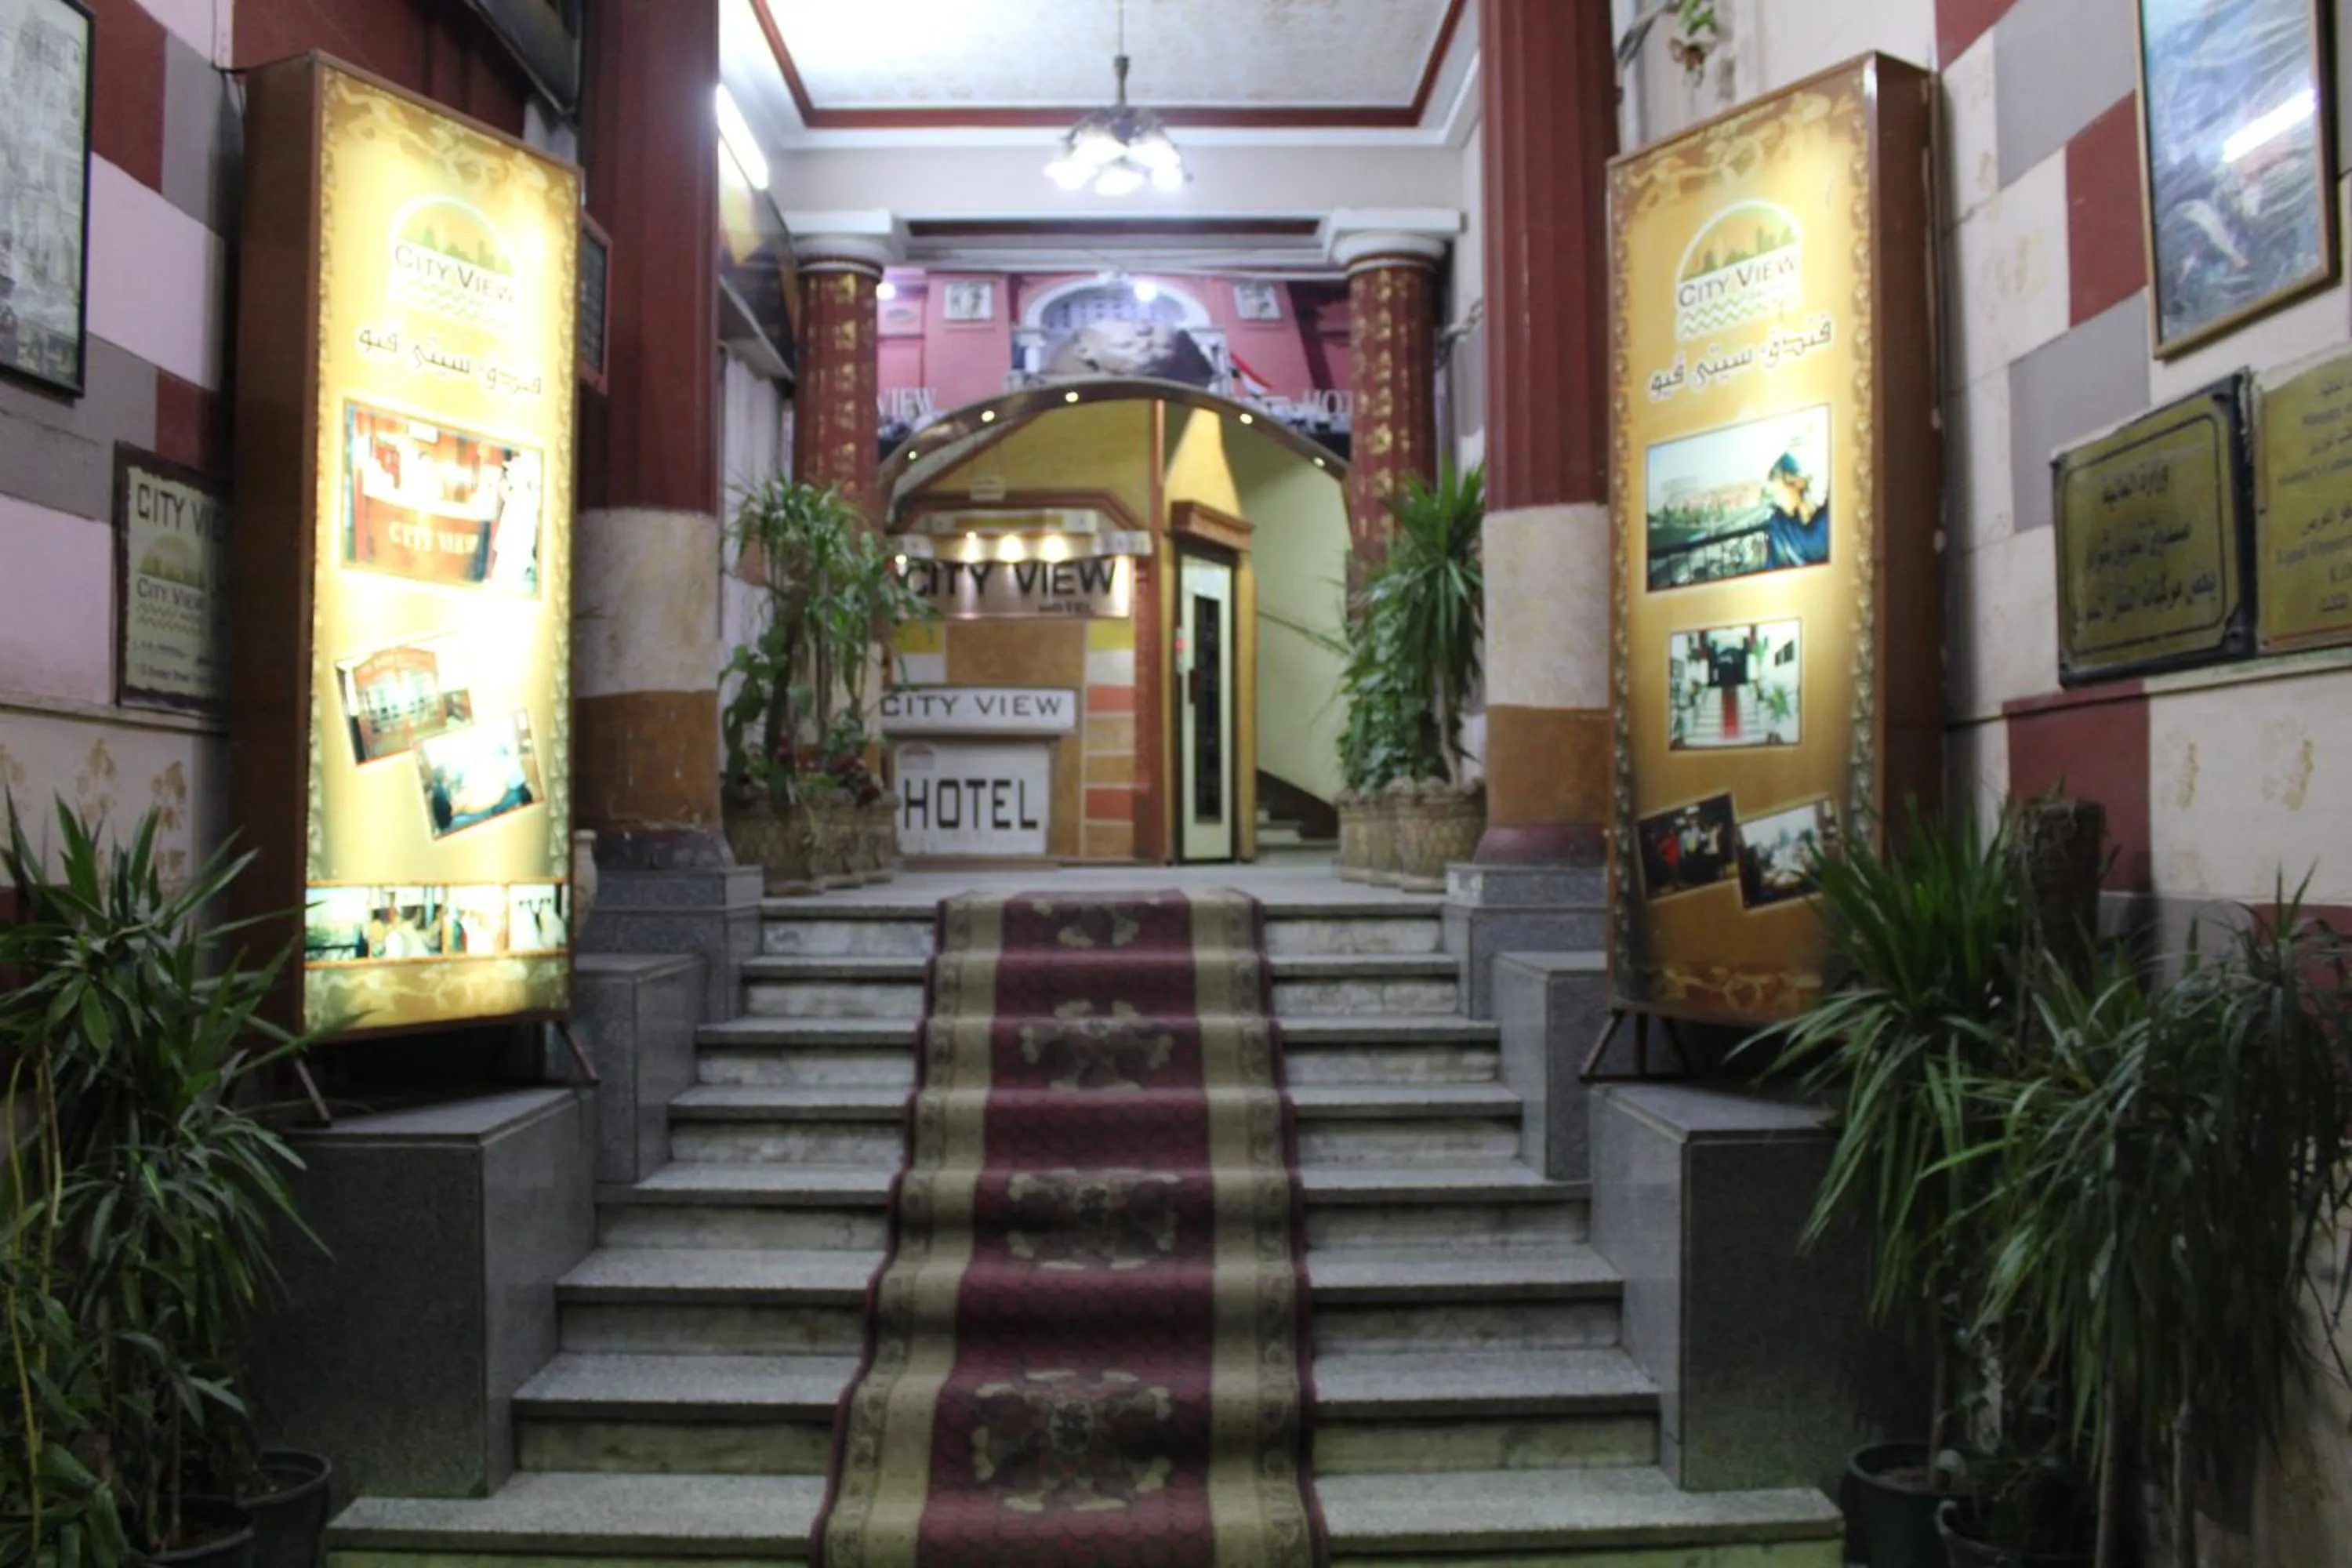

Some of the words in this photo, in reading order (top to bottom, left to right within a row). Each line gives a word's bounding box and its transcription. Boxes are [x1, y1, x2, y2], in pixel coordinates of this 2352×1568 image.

[395, 244, 448, 281] CITY
[1678, 276, 1730, 307] CITY
[136, 483, 185, 531] CITY
[136, 576, 169, 607] CITY
[904, 559, 993, 597] CITY
[1014, 557, 1116, 597] VIEW
[880, 695, 959, 717] CITY
[974, 695, 1062, 717] VIEW
[904, 778, 1039, 830] HOTEL
